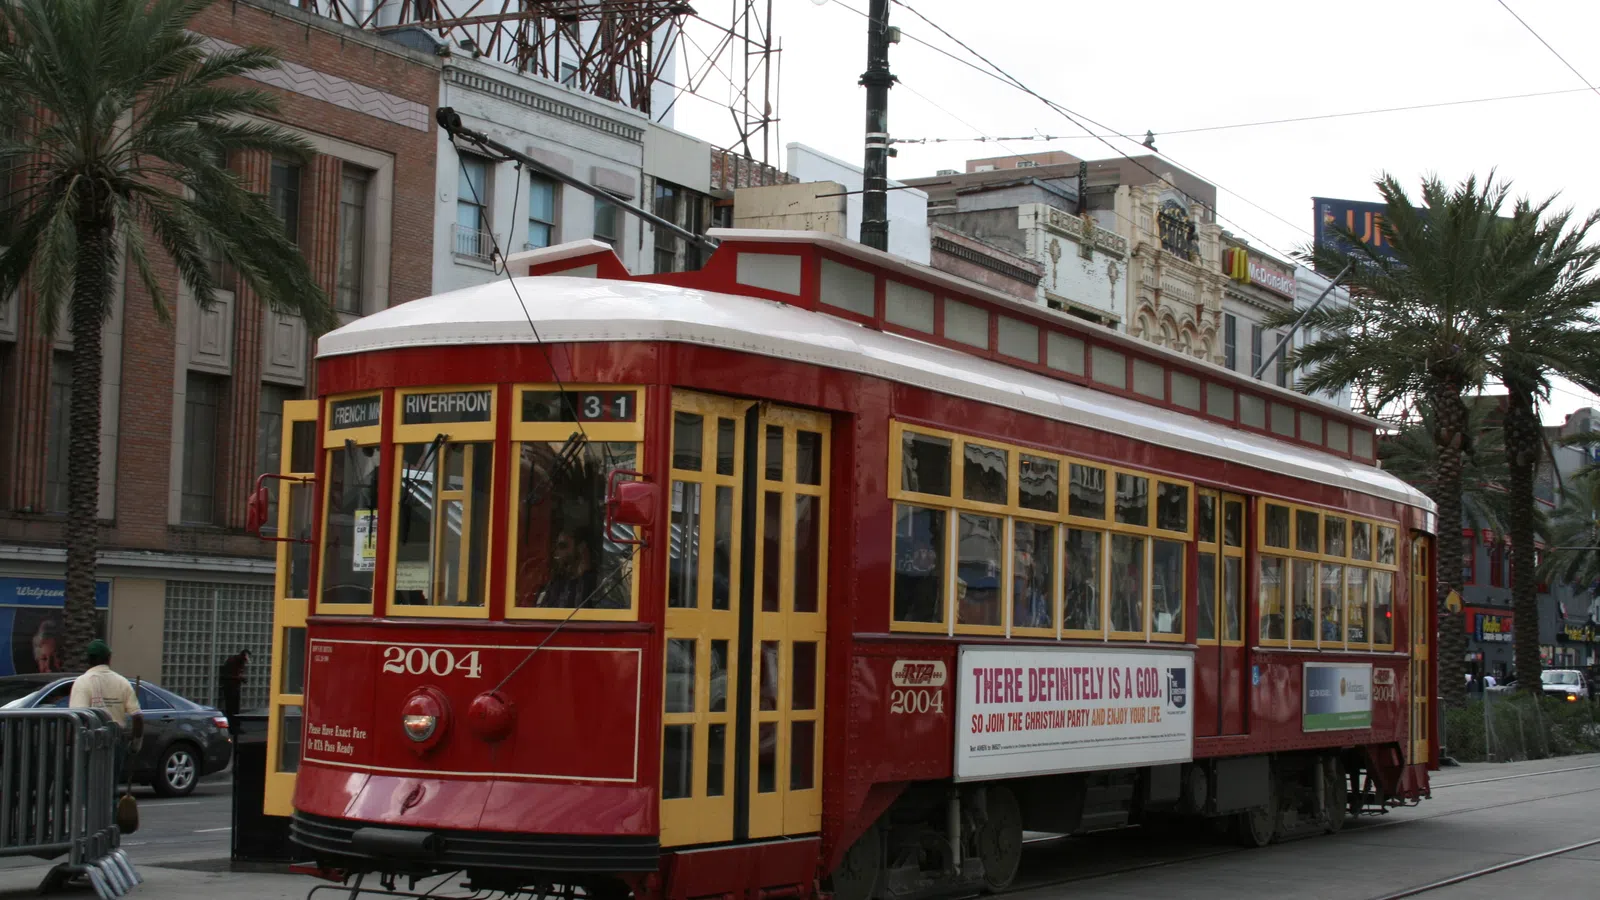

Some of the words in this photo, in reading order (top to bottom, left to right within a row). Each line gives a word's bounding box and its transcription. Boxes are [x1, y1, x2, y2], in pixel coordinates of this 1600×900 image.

[1248, 262, 1294, 295] McDonald's
[405, 391, 491, 413] RIVERFRON
[334, 404, 366, 424] FRENCH
[382, 646, 482, 679] 2004
[902, 663, 936, 685] RTA
[972, 667, 1024, 704] THERE
[1028, 667, 1104, 702] DEFINITELY
[1108, 667, 1121, 699] IS
[1124, 667, 1132, 699] A
[1136, 667, 1162, 698] GOD.
[1373, 686, 1395, 701] 2004
[890, 689, 944, 714] 2004
[322, 723, 334, 736] Have
[335, 725, 351, 738] Exact
[353, 726, 367, 739] Fare
[971, 714, 984, 734] SO
[985, 713, 1005, 733] JOIN
[1007, 712, 1023, 731] THE
[1025, 710, 1065, 730] CHRISTIAN
[1067, 709, 1090, 728] PARTY
[1091, 708, 1106, 726] AND
[1107, 708, 1128, 725] ENJOY
[1129, 707, 1145, 724] YOUR
[1147, 706, 1161, 723] LIFE.
[325, 740, 336, 753] Pass
[336, 741, 354, 756] Ready
